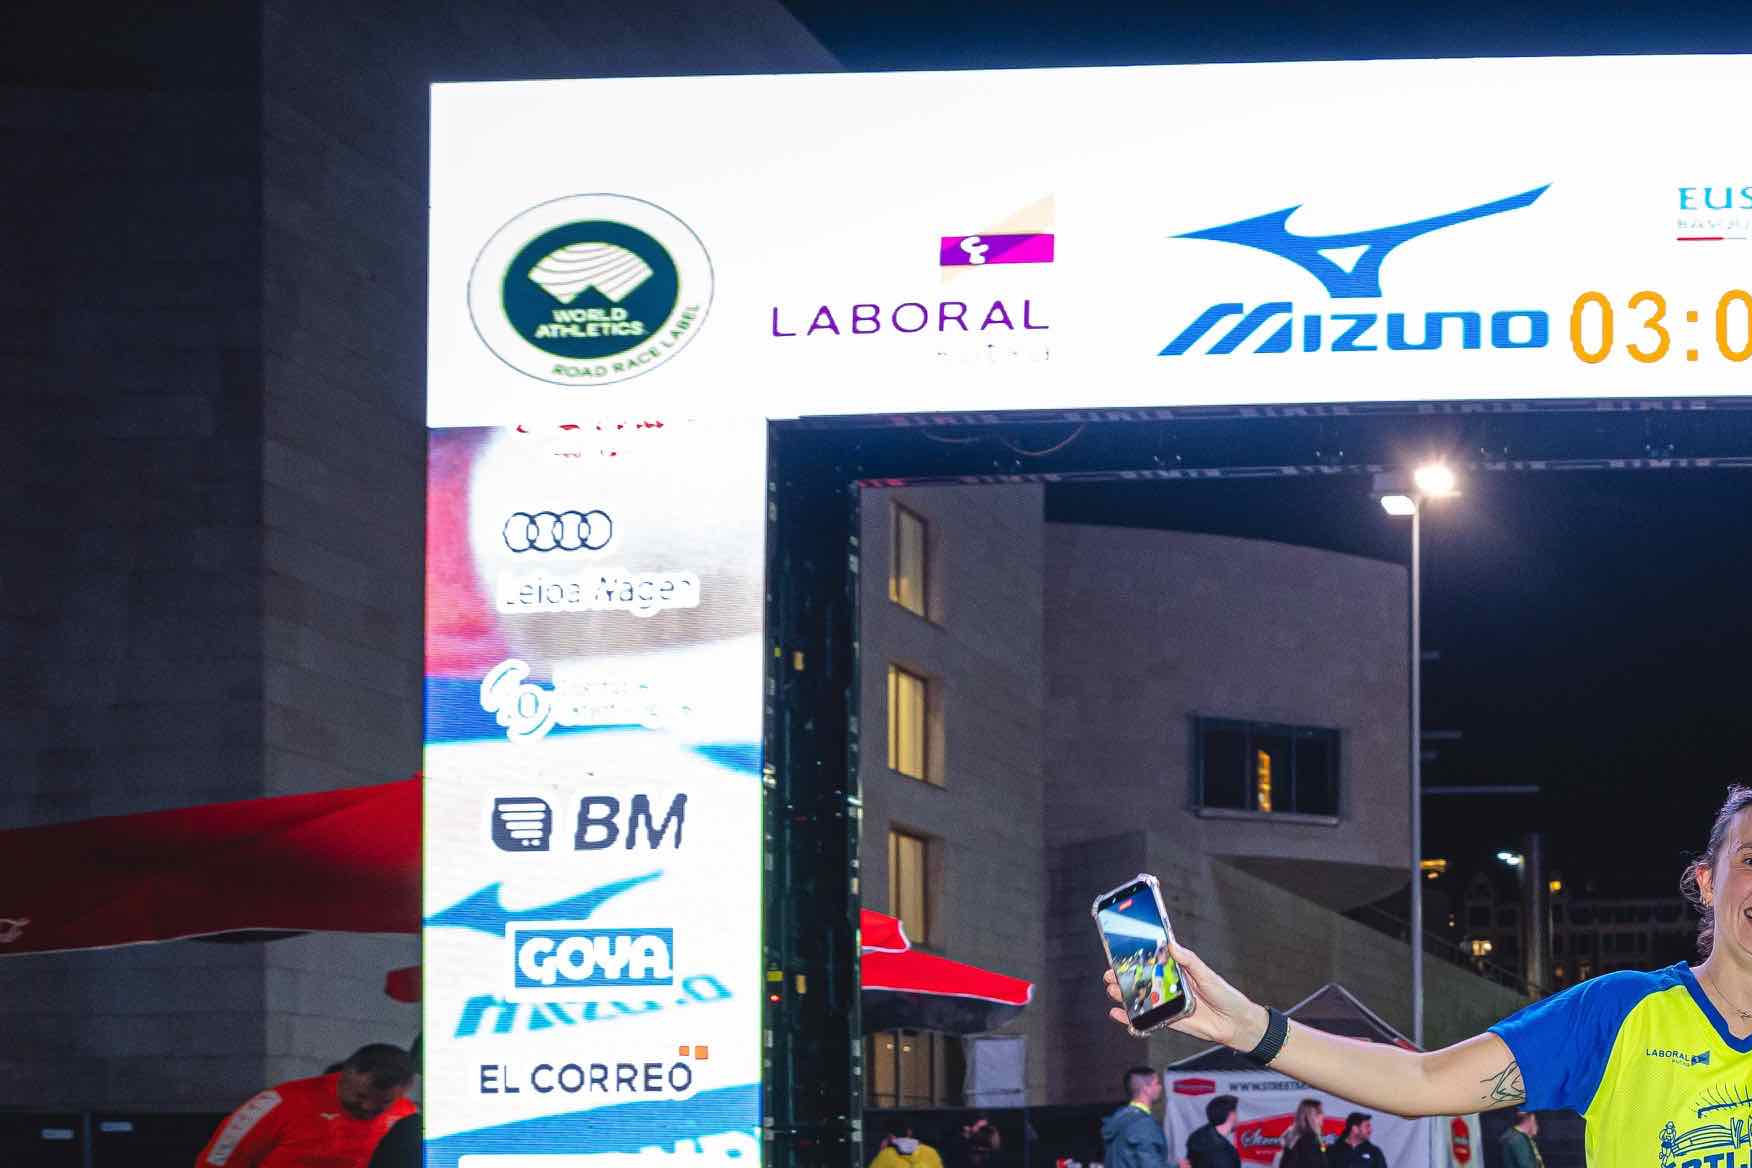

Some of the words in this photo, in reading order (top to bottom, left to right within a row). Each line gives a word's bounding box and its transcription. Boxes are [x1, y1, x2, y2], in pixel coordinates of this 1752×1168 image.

[535, 321, 646, 338] ATHLETICS
[551, 307, 629, 323] WORLD
[771, 300, 1050, 338] LABORAL
[551, 363, 608, 378] ROAD
[612, 345, 662, 374] RACE
[660, 303, 702, 349] LABEL
[573, 792, 688, 851] BM
[517, 934, 673, 985] GOYA
[1646, 1048, 1690, 1062] LABORAL
[480, 1064, 520, 1093] EL
[530, 1062, 693, 1093] CORREO
